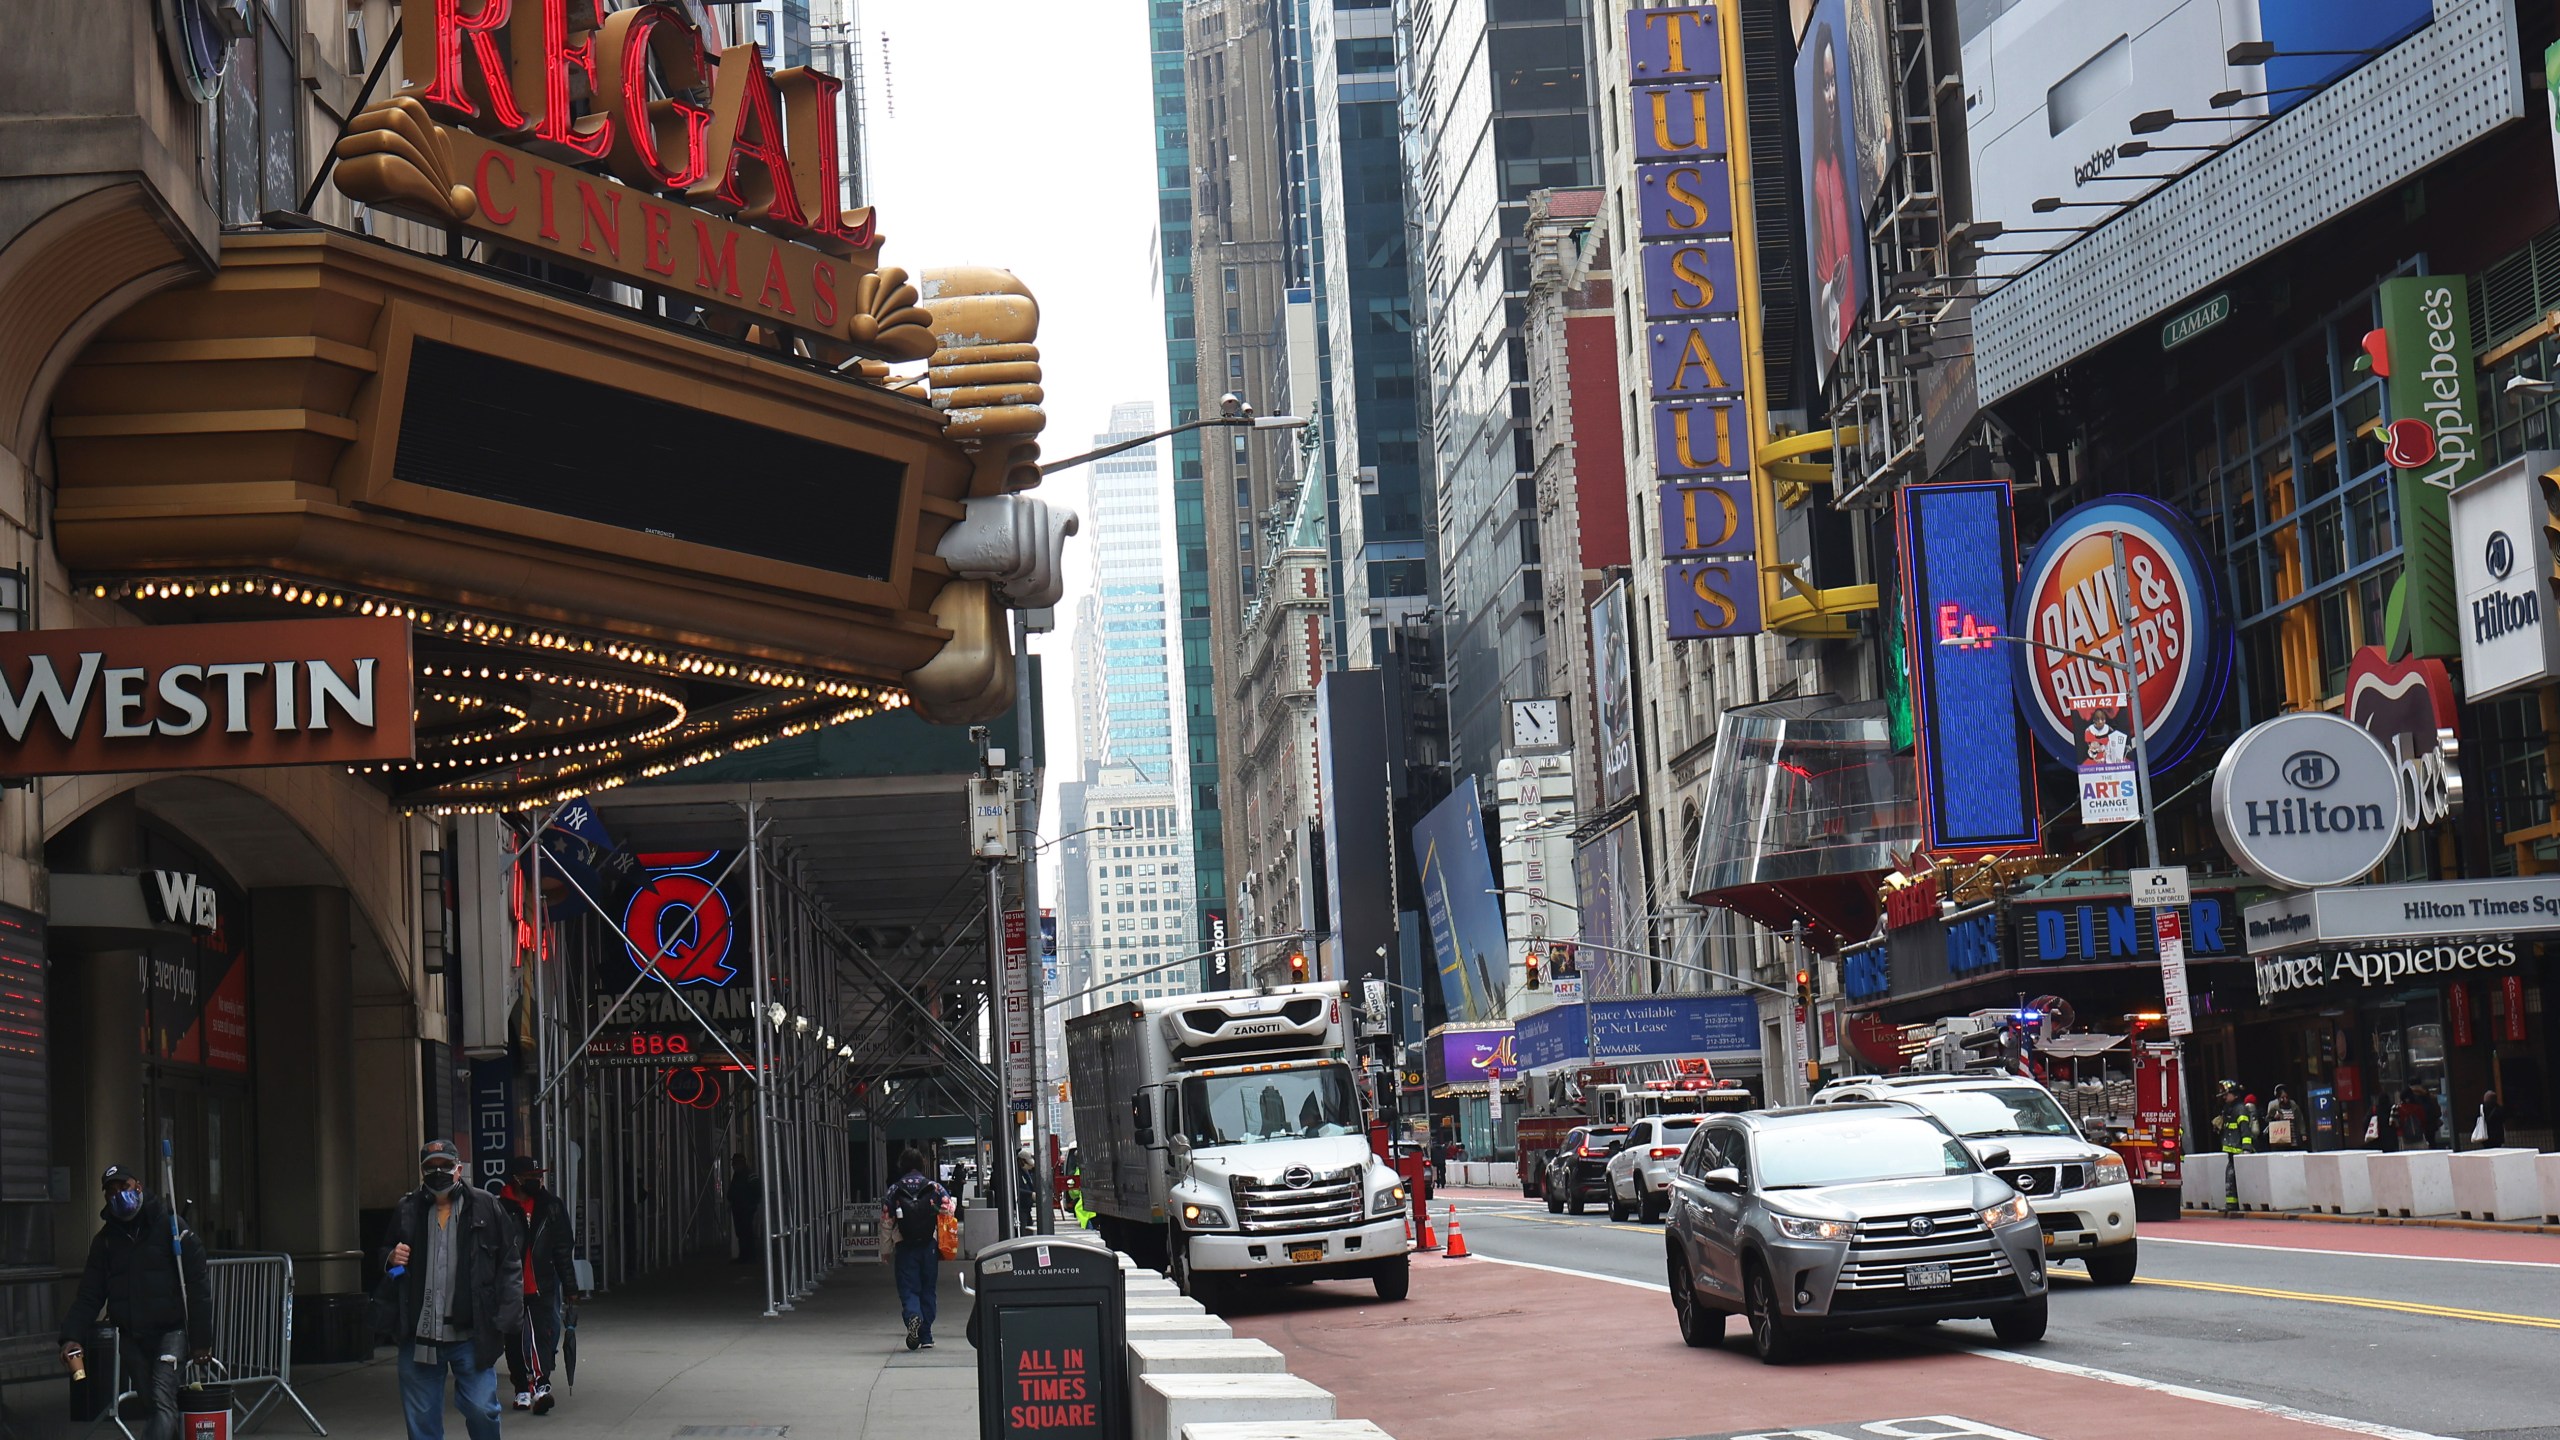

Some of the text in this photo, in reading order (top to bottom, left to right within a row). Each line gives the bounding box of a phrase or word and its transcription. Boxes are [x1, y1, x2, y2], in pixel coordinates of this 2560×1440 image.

[422, 0, 877, 250] REGAL
[2073, 144, 2116, 188] brother
[474, 149, 839, 328] CINEMAS
[1645, 10, 1739, 632] TUSSAUD'S
[2171, 302, 2219, 342] LAMAR
[2421, 286, 2476, 490] Applebee's
[2042, 555, 2171, 668] DAVE &
[2472, 588, 2540, 645] Hilton
[0, 651, 378, 743] WESTIN
[2073, 698, 2112, 709] NEW 42
[1605, 744, 1630, 777] ALDO
[2083, 780, 2135, 800] ARTS
[2089, 799, 2128, 808] CHANGE
[2245, 797, 2385, 837] Hilton
[2404, 899, 2466, 919] Hilton
[2469, 897, 2529, 917] Times
[2036, 899, 2226, 961] DINR
[1212, 920, 1226, 975] verizon
[155, 959, 178, 1002] every
[179, 958, 197, 1005] day.
[1554, 983, 1581, 993] ARTS
[1624, 1006, 1676, 1019] Available
[1234, 1023, 1280, 1035] ZANOTTI
[1593, 1021, 1667, 1034] or Net Lease
[632, 1034, 688, 1055] BBQ
[1475, 1044, 1493, 1052] Disney
[1594, 1044, 1642, 1055] EWMARK
[610, 1057, 650, 1065] CHICKEN
[661, 1055, 694, 1063] STEAKS
[845, 1238, 880, 1247] DANGER
[1038, 1267, 1080, 1275] COMPACTOR
[1018, 1349, 1083, 1370] ALL IN
[1018, 1378, 1086, 1401] TIMES
[1011, 1405, 1096, 1430] SQUARE
